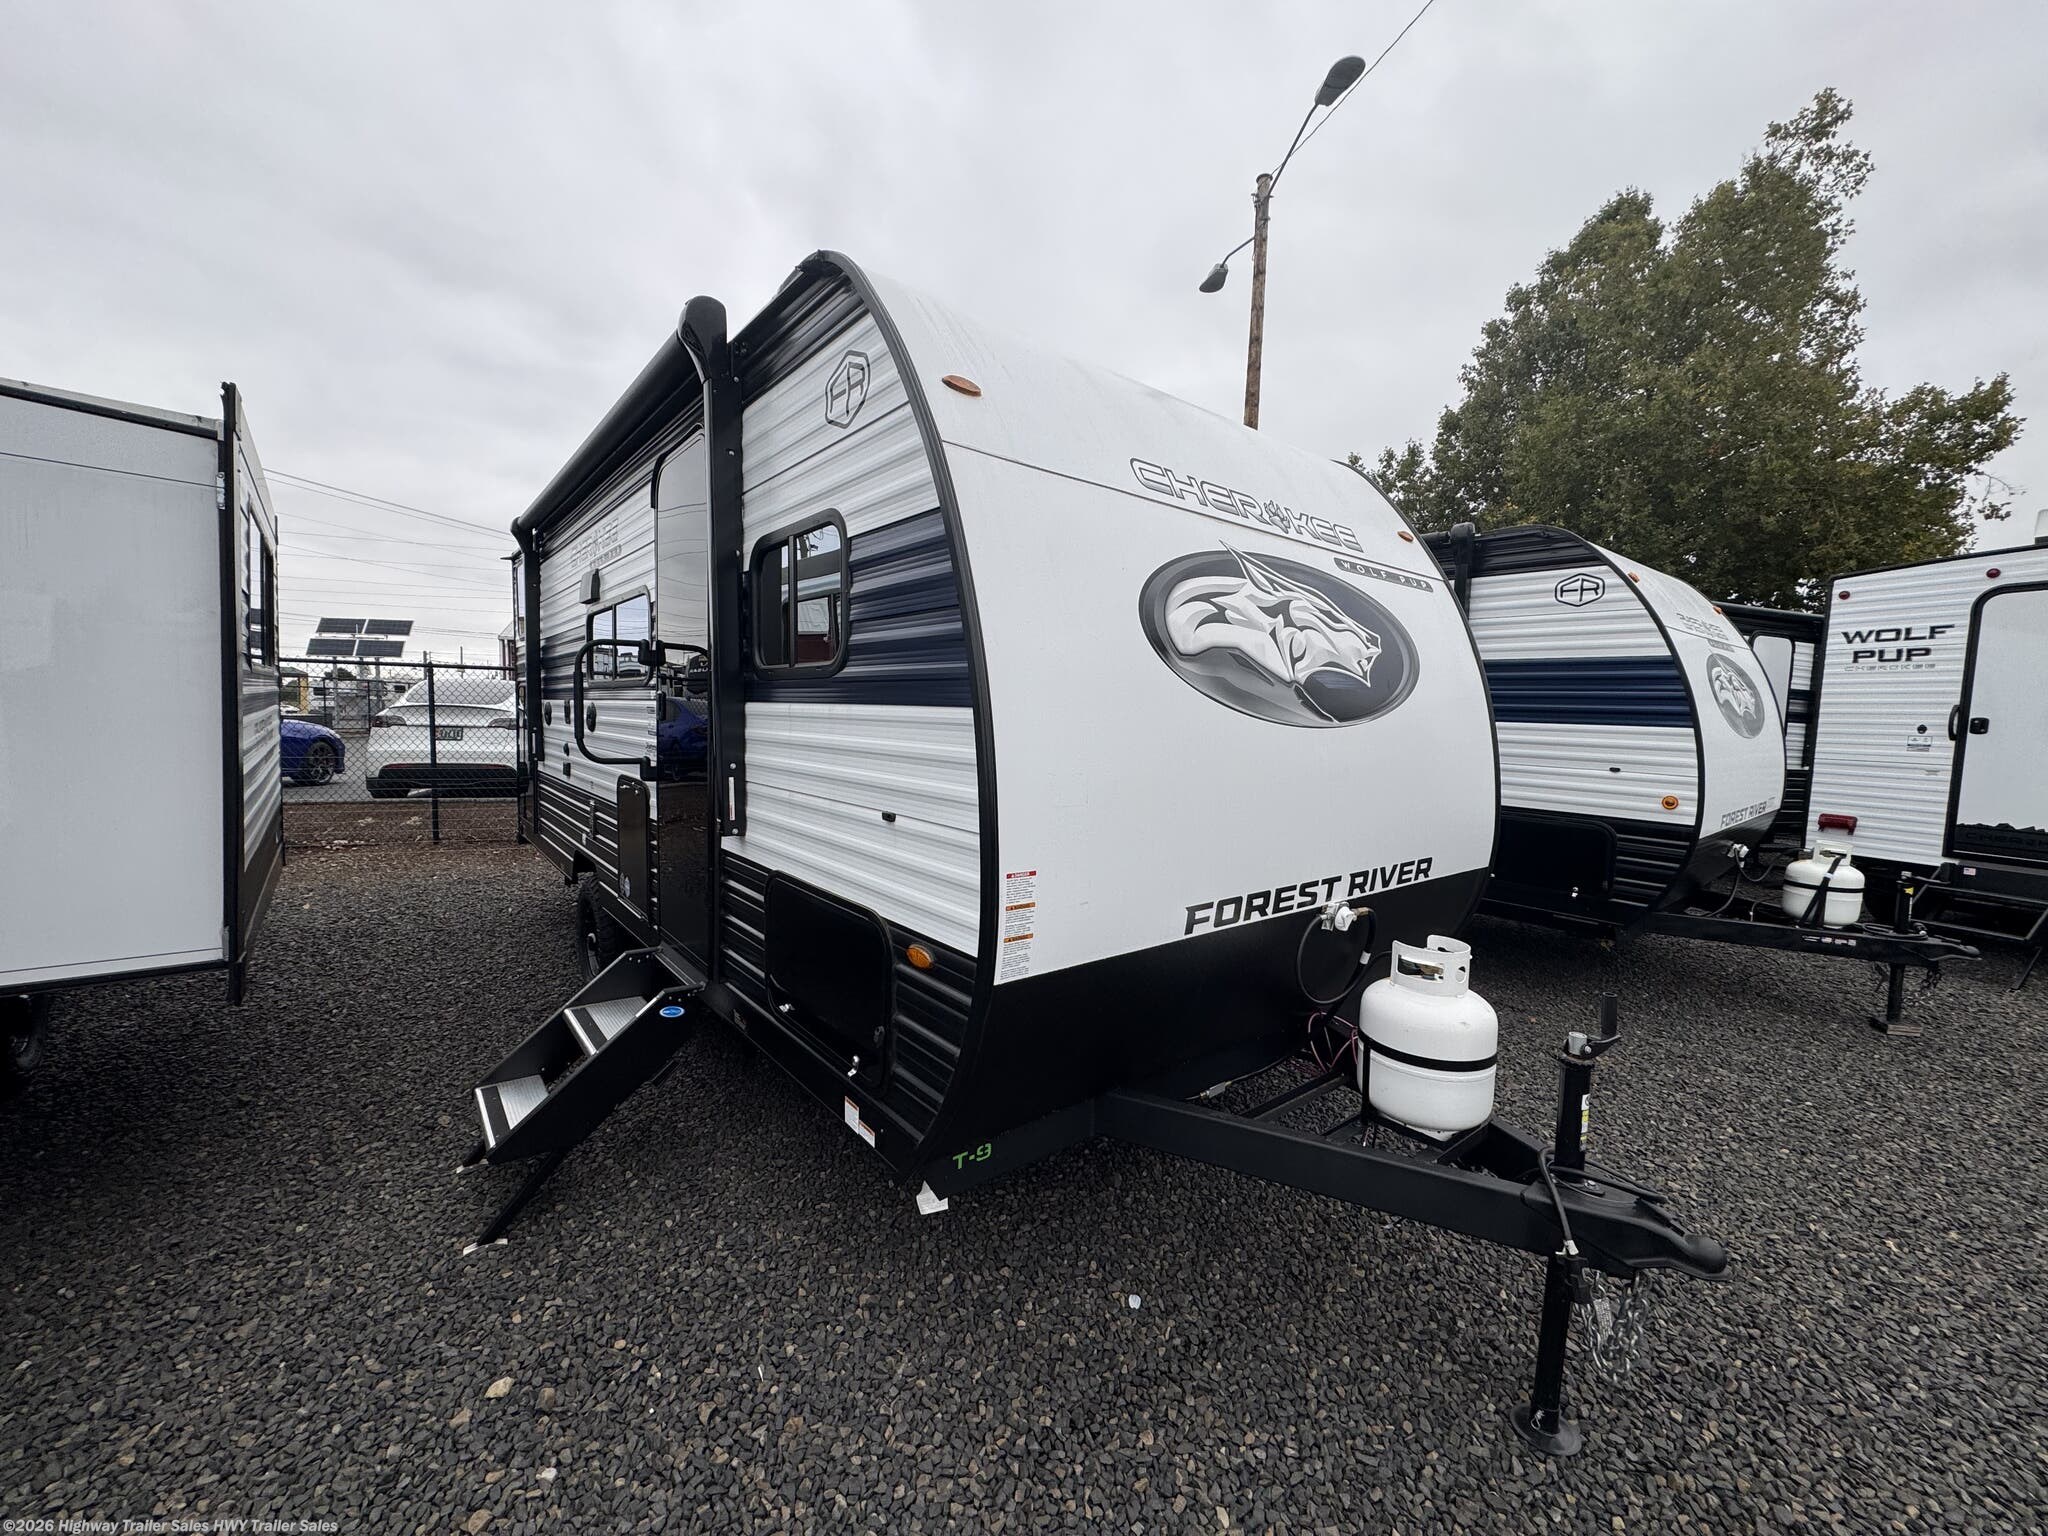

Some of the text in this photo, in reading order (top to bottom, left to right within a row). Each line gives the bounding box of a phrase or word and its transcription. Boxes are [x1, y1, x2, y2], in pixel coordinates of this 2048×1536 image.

[1341, 560, 1427, 589] WOLF PUP
[1841, 624, 1955, 644] WOLF
[1852, 647, 1932, 663] PUP
[1184, 857, 1433, 936] FOREST RIVER
[952, 1143, 992, 1170] T-9
